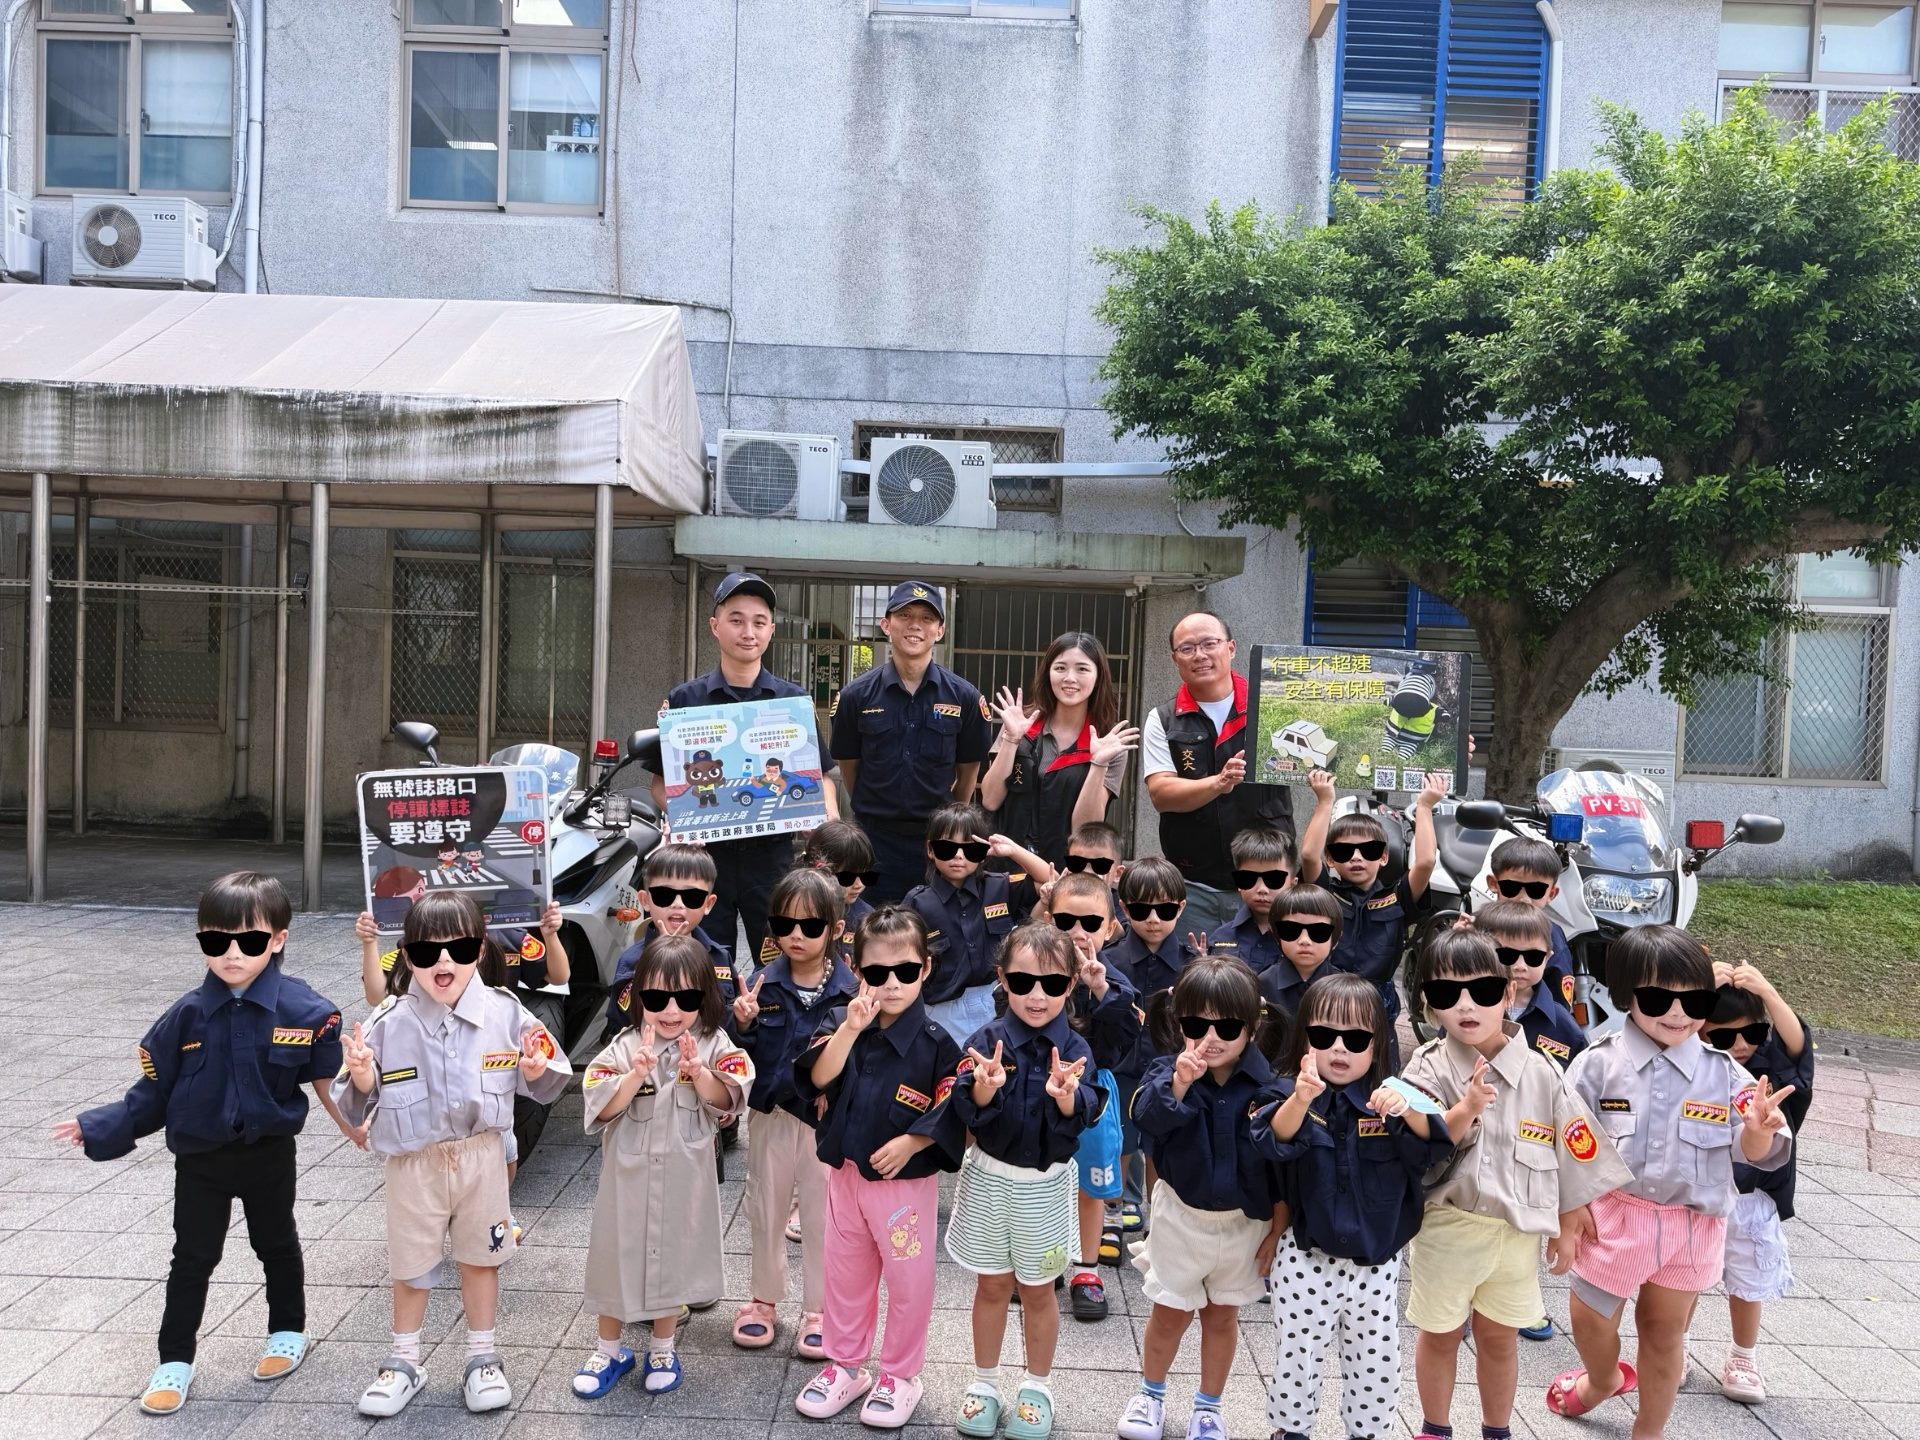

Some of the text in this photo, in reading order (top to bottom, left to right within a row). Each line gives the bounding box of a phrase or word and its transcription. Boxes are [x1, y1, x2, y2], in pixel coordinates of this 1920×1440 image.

[153, 213, 177, 221] TECO
[1271, 654, 1373, 675] 行車不超速
[1285, 680, 1387, 701] 安全有保障
[1182, 749, 1197, 771] 交大
[372, 777, 477, 799] 無號誌路口
[387, 798, 471, 819] 停讓標誌
[1588, 798, 1640, 814] PV-31
[388, 819, 472, 846] 要遵守
[527, 825, 542, 840] 停
[688, 821, 776, 842] 臺北市政府警察局
